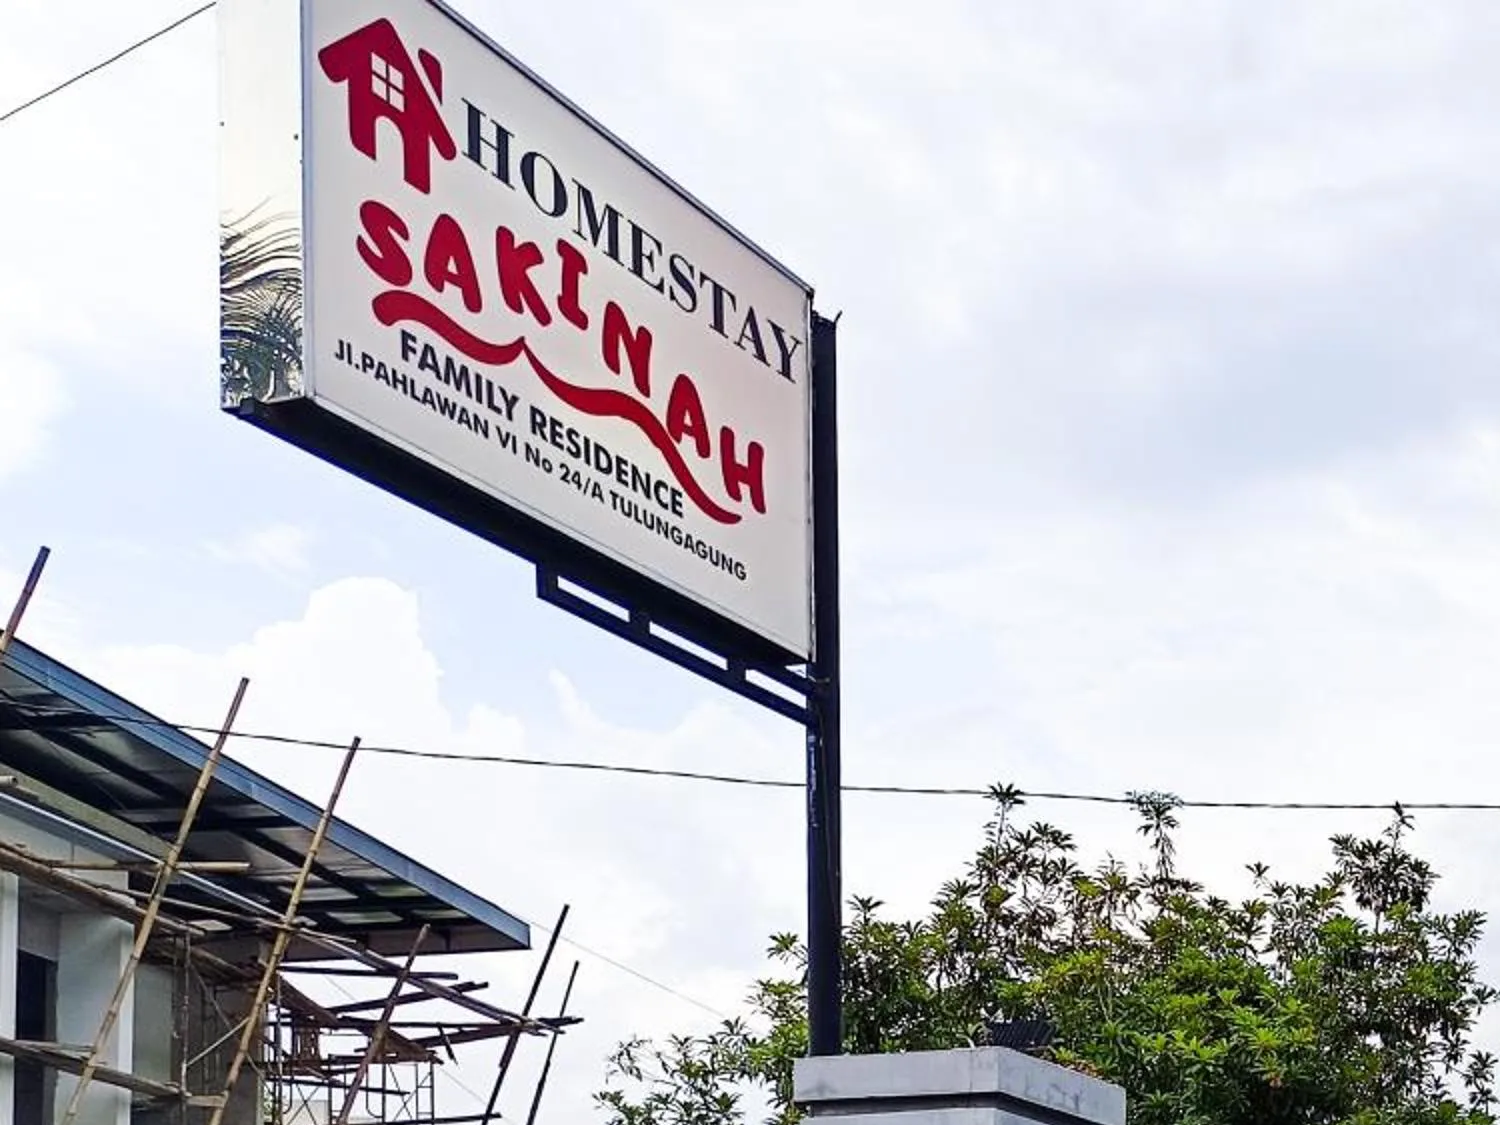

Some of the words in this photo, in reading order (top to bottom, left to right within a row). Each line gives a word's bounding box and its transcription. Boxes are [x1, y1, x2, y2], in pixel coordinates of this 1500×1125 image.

[356, 200, 767, 514] SAKINAH
[460, 97, 804, 385] HOMESTAY
[400, 329, 520, 422] FAMILY
[529, 405, 685, 519] RESIDENCE
[495, 425, 518, 456] VI
[524, 441, 554, 474] No
[559, 462, 606, 505] 24/A
[608, 489, 748, 581] TULUNGAGUNG
